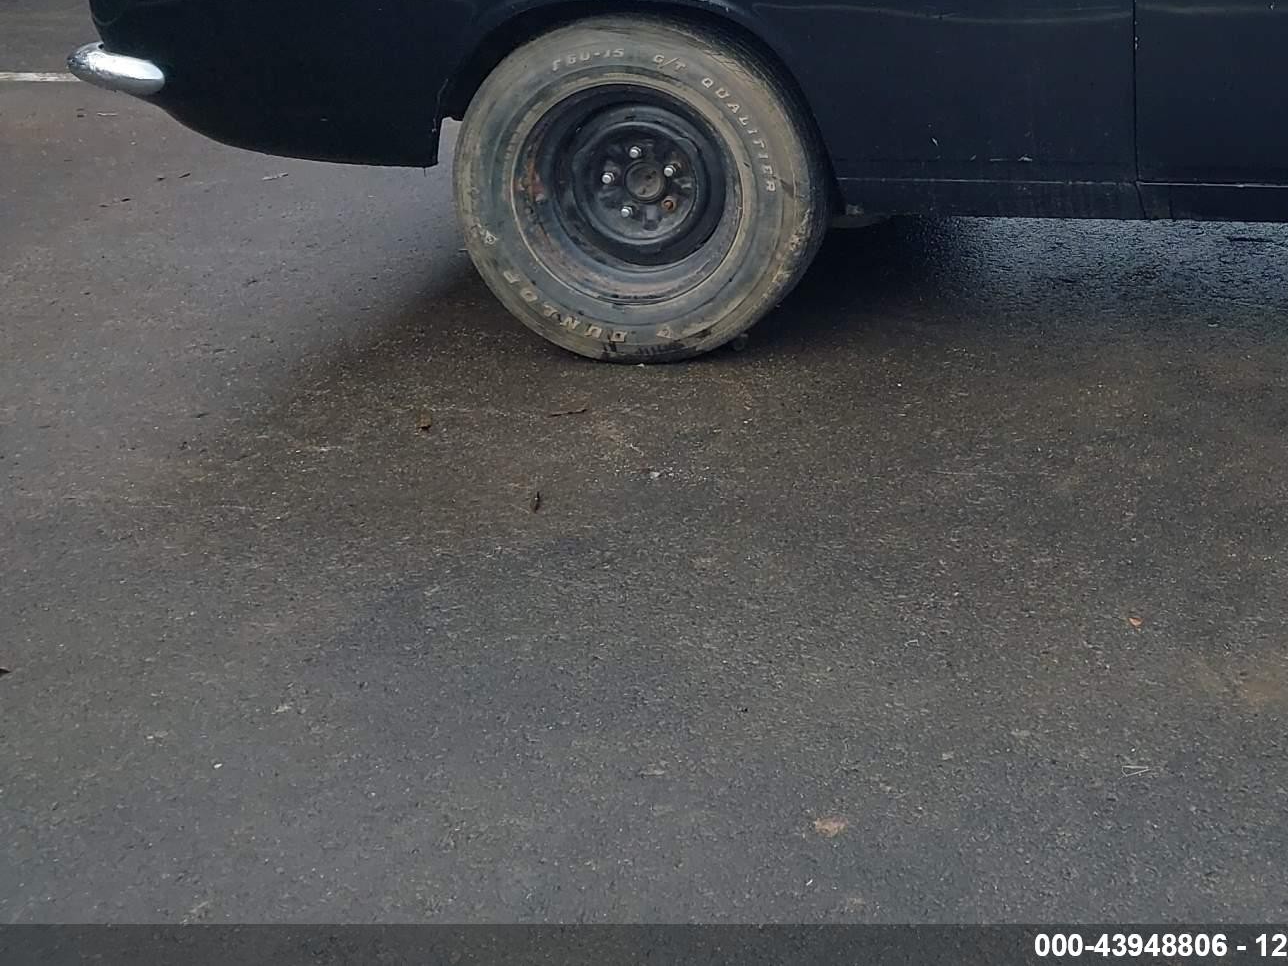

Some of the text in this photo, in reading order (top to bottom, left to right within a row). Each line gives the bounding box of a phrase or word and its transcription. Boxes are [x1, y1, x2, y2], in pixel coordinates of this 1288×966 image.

[653, 53, 687, 71] G/T
[701, 77, 777, 193] QUALIFIER
[503, 270, 628, 343] DUNLOP
